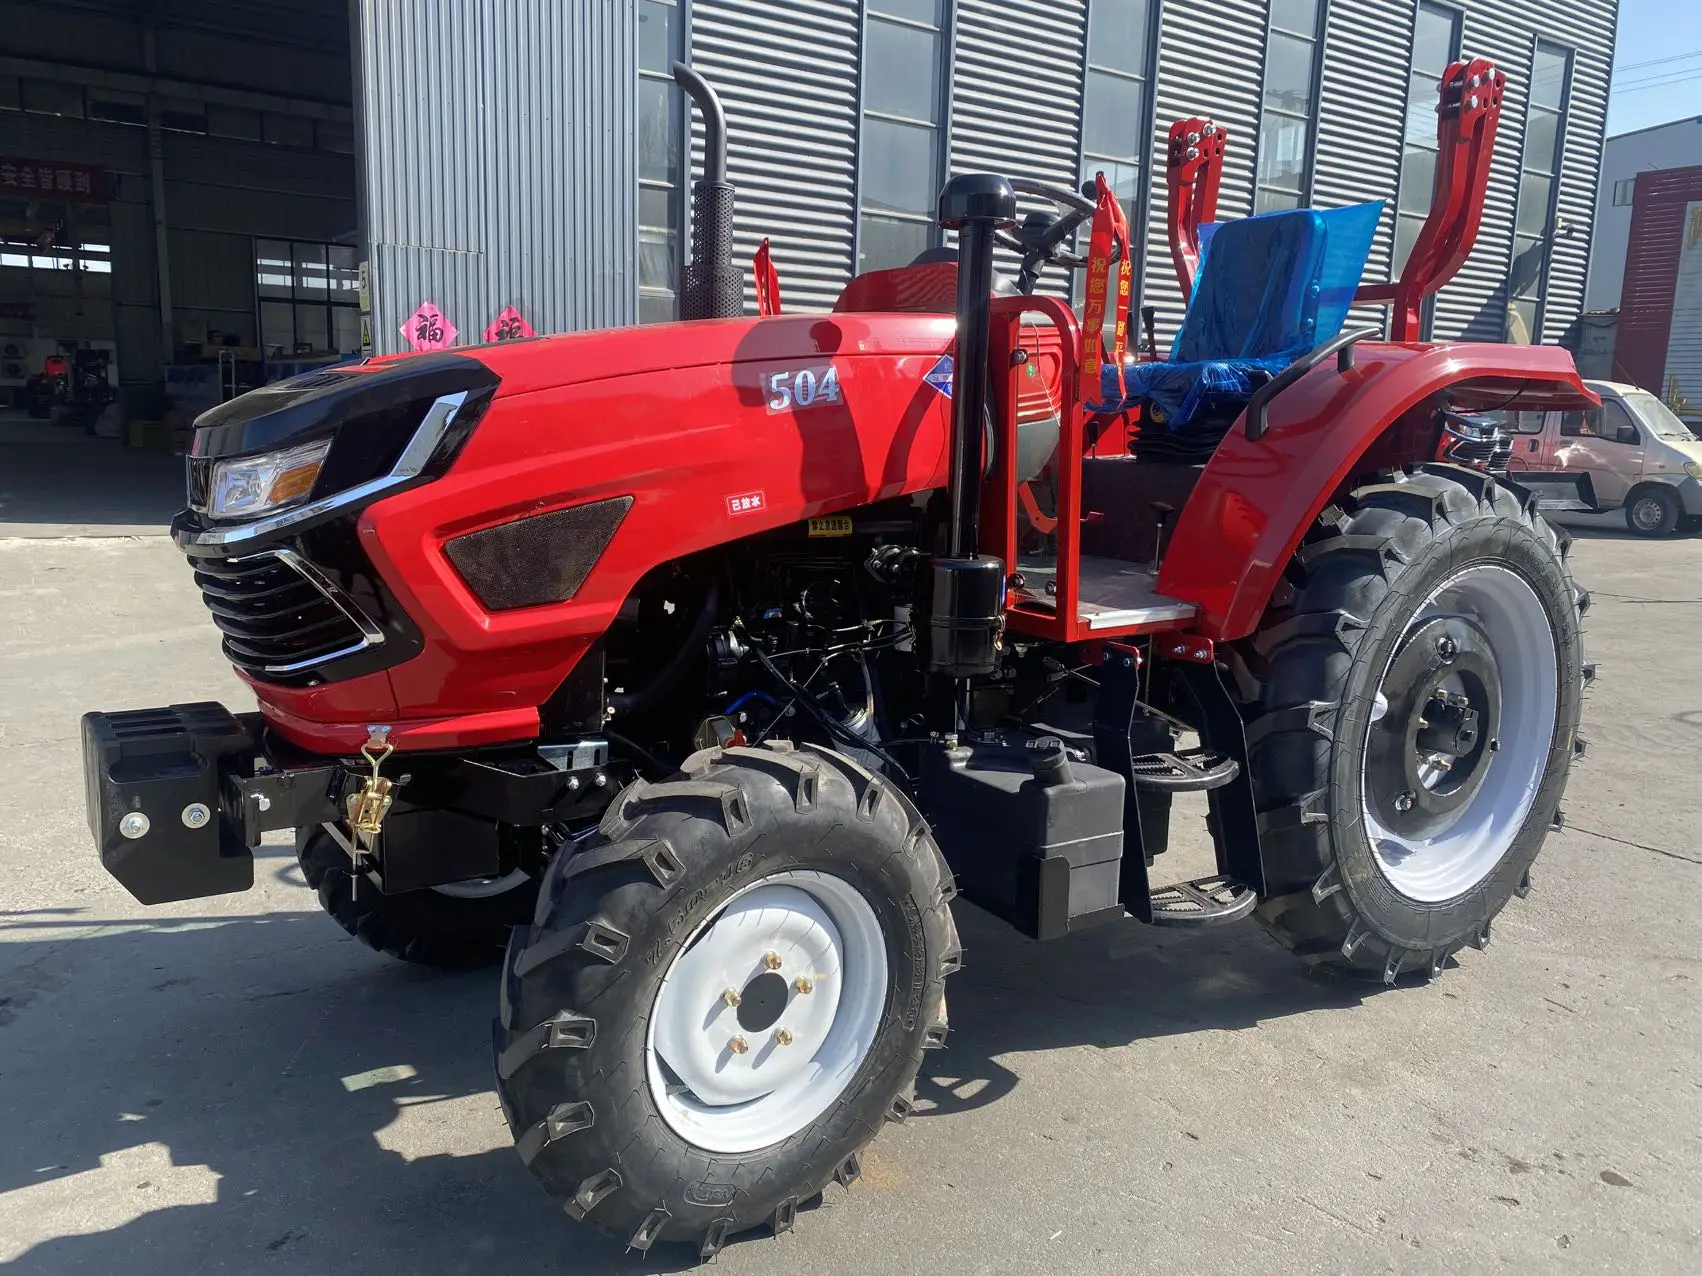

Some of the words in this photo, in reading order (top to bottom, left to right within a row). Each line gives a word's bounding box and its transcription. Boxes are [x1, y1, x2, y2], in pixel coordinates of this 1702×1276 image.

[415, 313, 444, 344] 福
[1084, 257, 1106, 374] 祝您万事如意
[769, 366, 840, 410] 504
